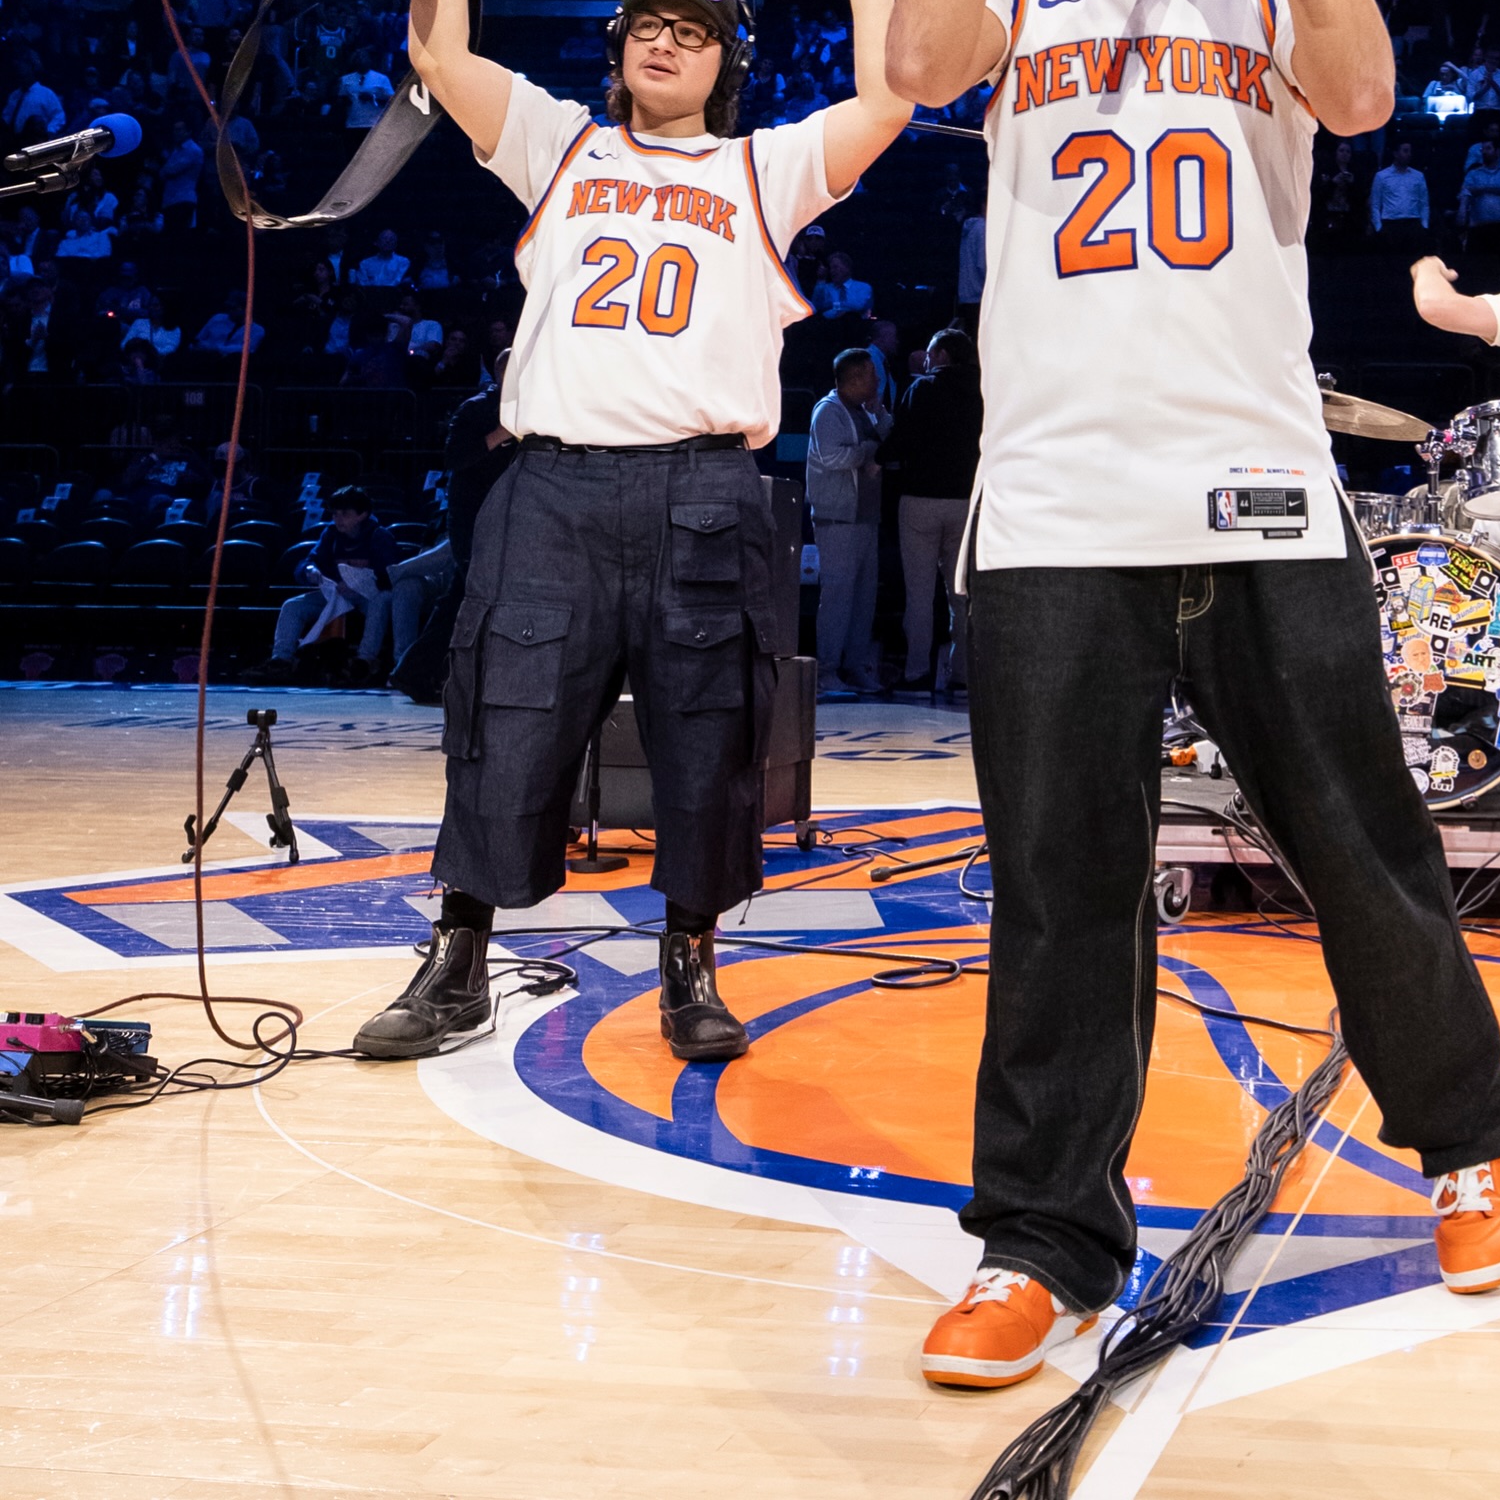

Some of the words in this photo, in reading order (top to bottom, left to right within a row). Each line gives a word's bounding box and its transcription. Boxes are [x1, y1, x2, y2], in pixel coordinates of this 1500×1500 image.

[1013, 37, 1131, 115] NEW
[1134, 35, 1273, 115] YORK
[565, 179, 651, 220] NEW
[652, 183, 738, 243] YORK
[1052, 128, 1233, 280] 20
[571, 236, 699, 338] 20
[1239, 499, 1249, 508] 44
